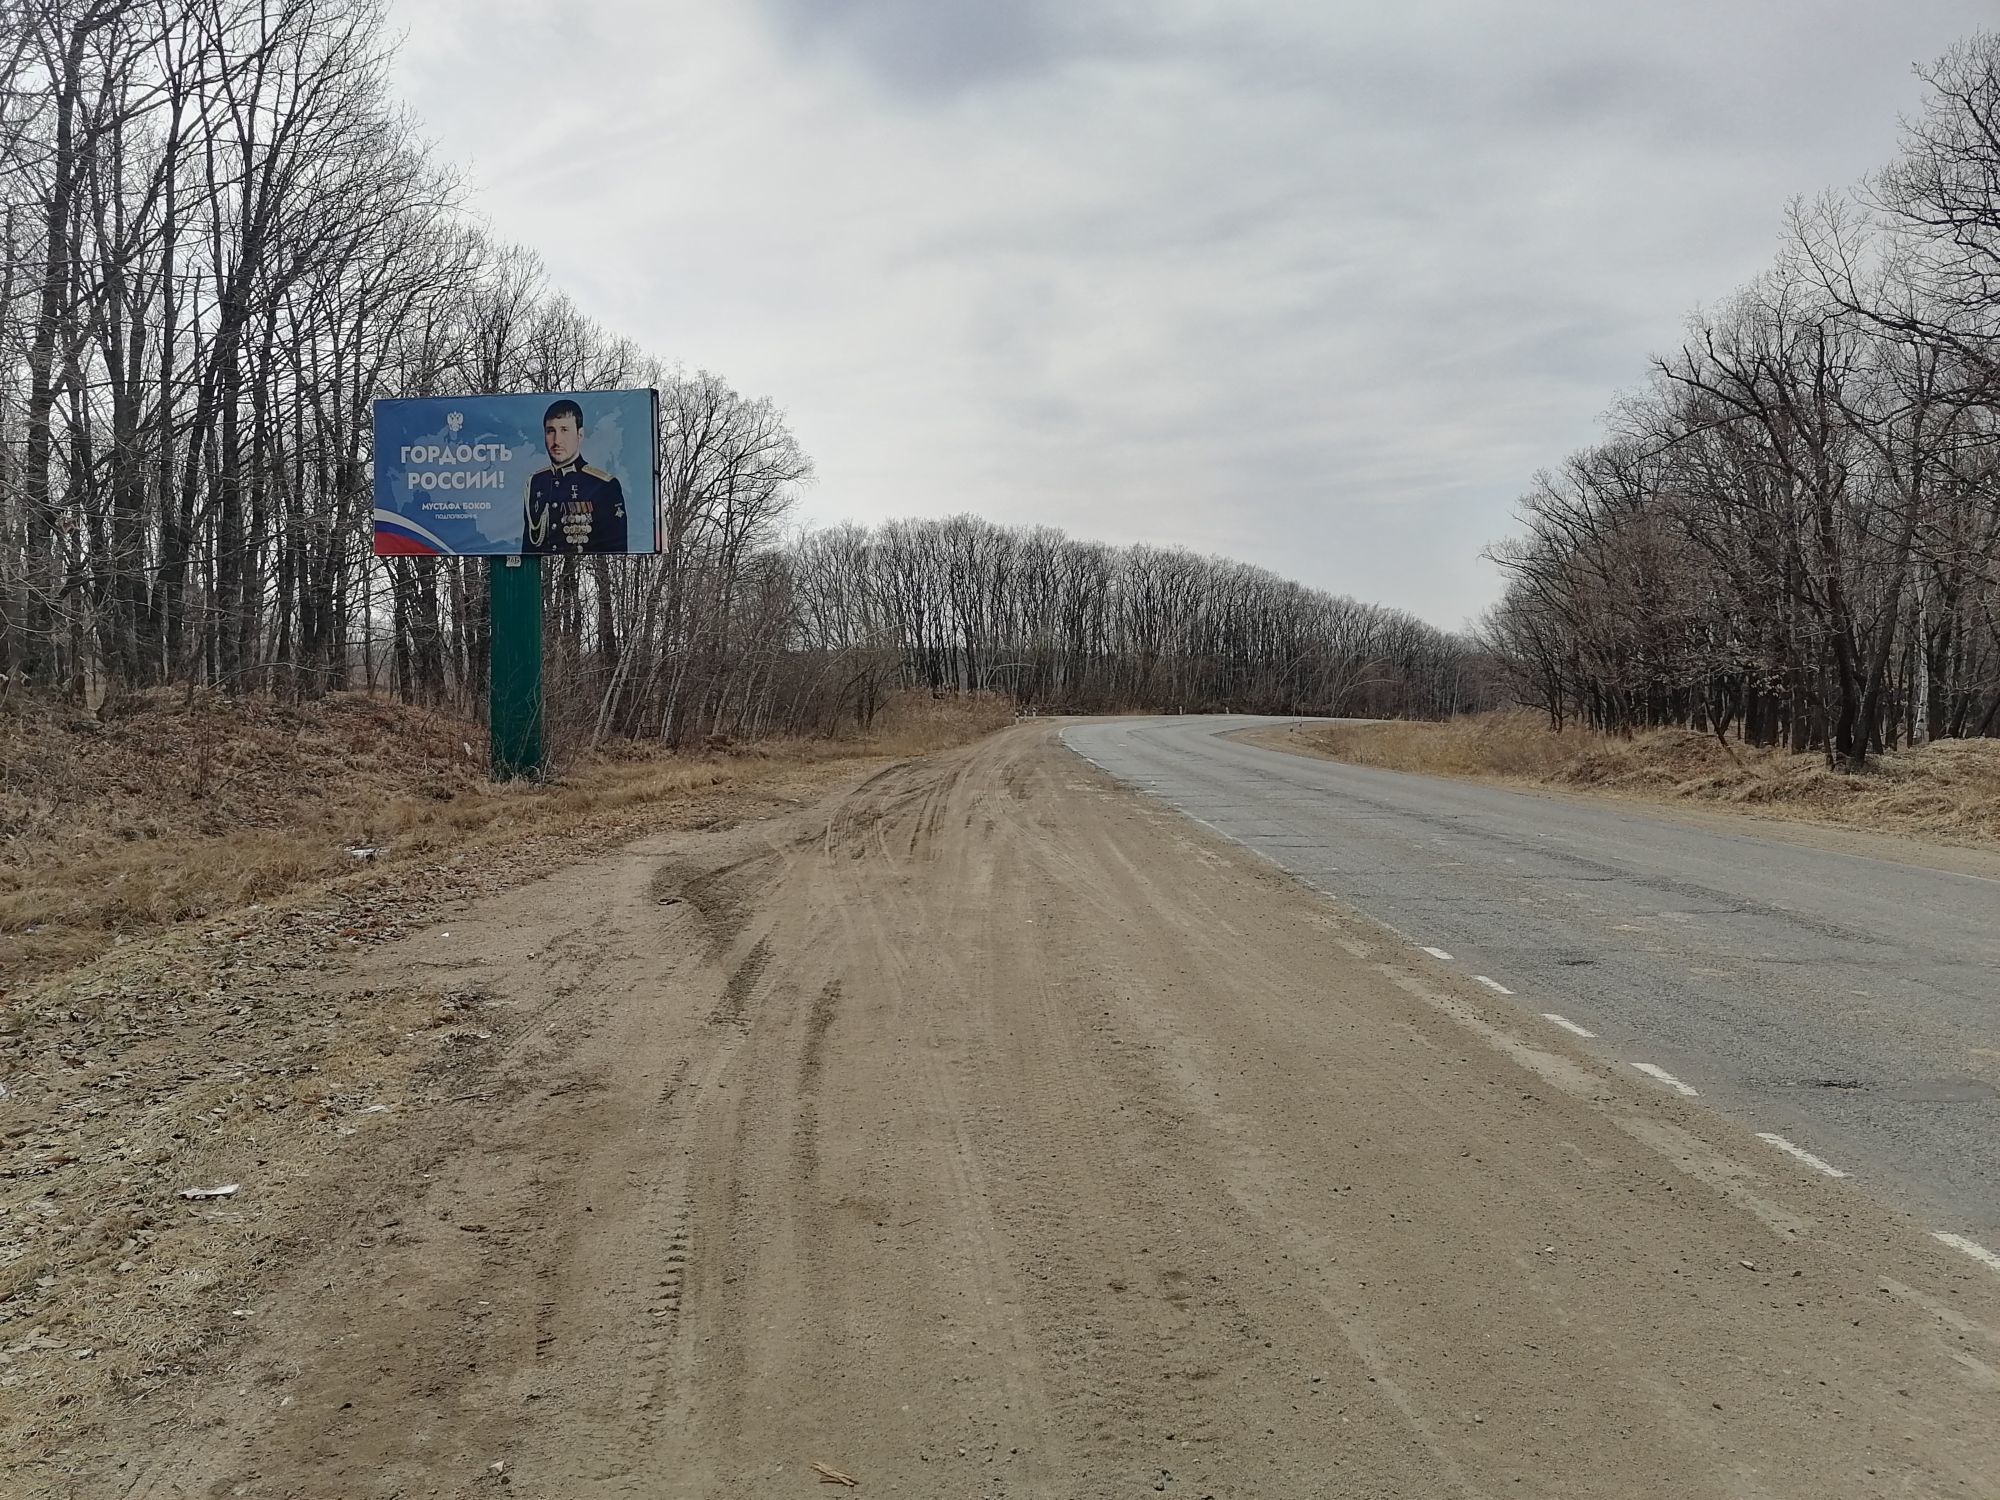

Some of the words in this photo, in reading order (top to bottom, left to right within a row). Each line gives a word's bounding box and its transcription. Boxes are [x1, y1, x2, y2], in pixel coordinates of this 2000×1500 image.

[400, 443, 513, 465] ГОРДОСТЬ
[408, 471, 505, 490] РОССИИ!
[422, 502, 461, 511] МУСТАФА
